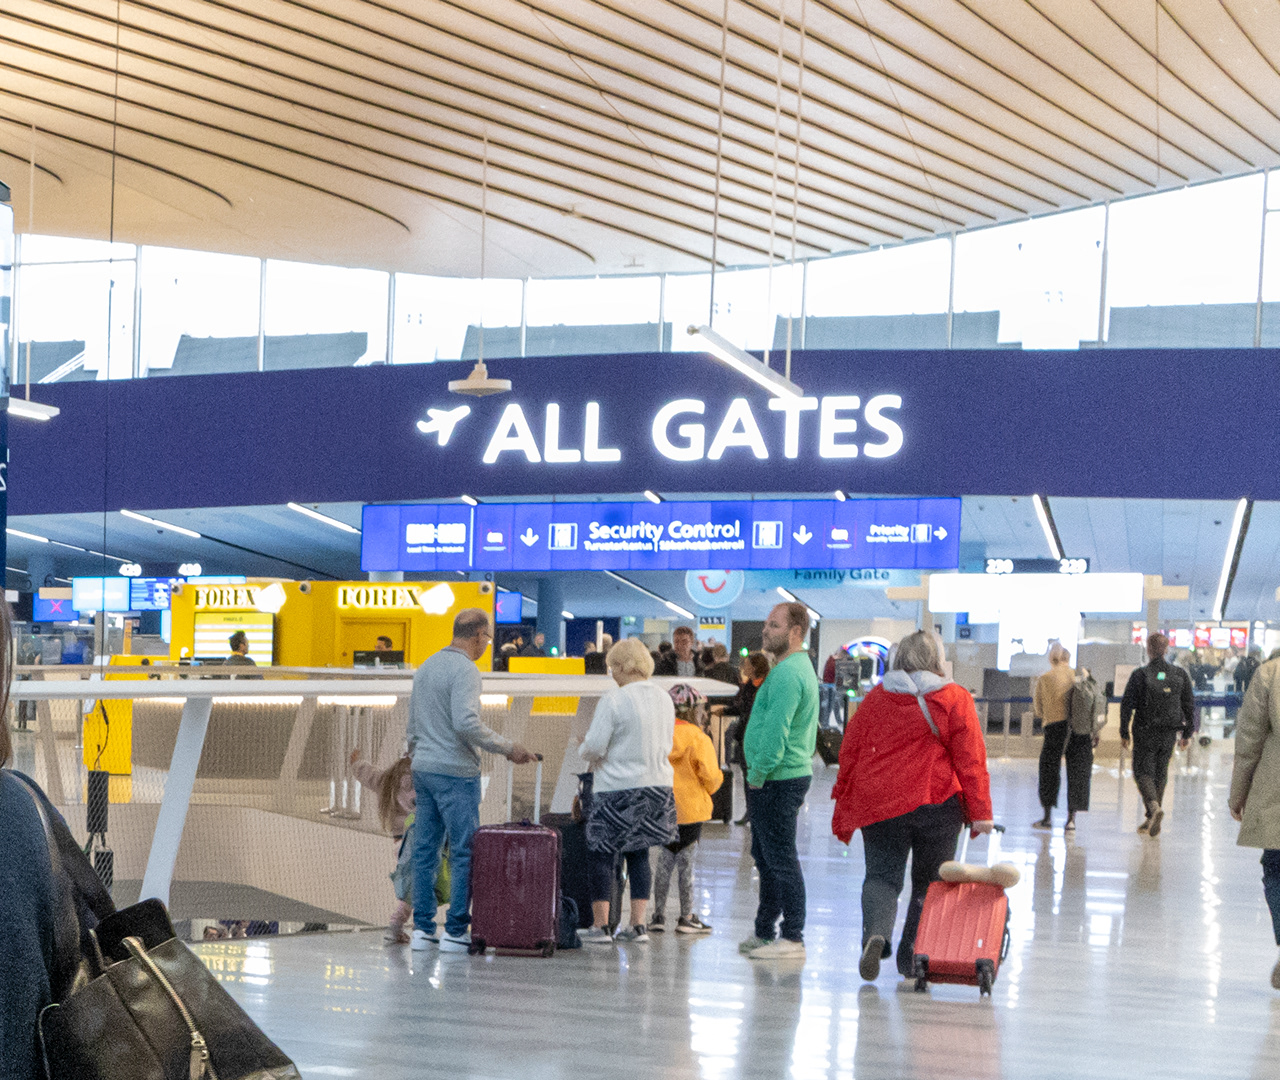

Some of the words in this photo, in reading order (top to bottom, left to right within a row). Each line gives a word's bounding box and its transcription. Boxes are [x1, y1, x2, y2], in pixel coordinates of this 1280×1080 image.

[483, 402, 621, 463] ALL
[651, 393, 904, 461] GATES
[588, 520, 666, 549] Security
[668, 518, 741, 540] Control
[794, 569, 844, 582] Family
[848, 569, 890, 580] Gate
[194, 587, 257, 608] FOREX
[339, 587, 421, 608] FOREX
